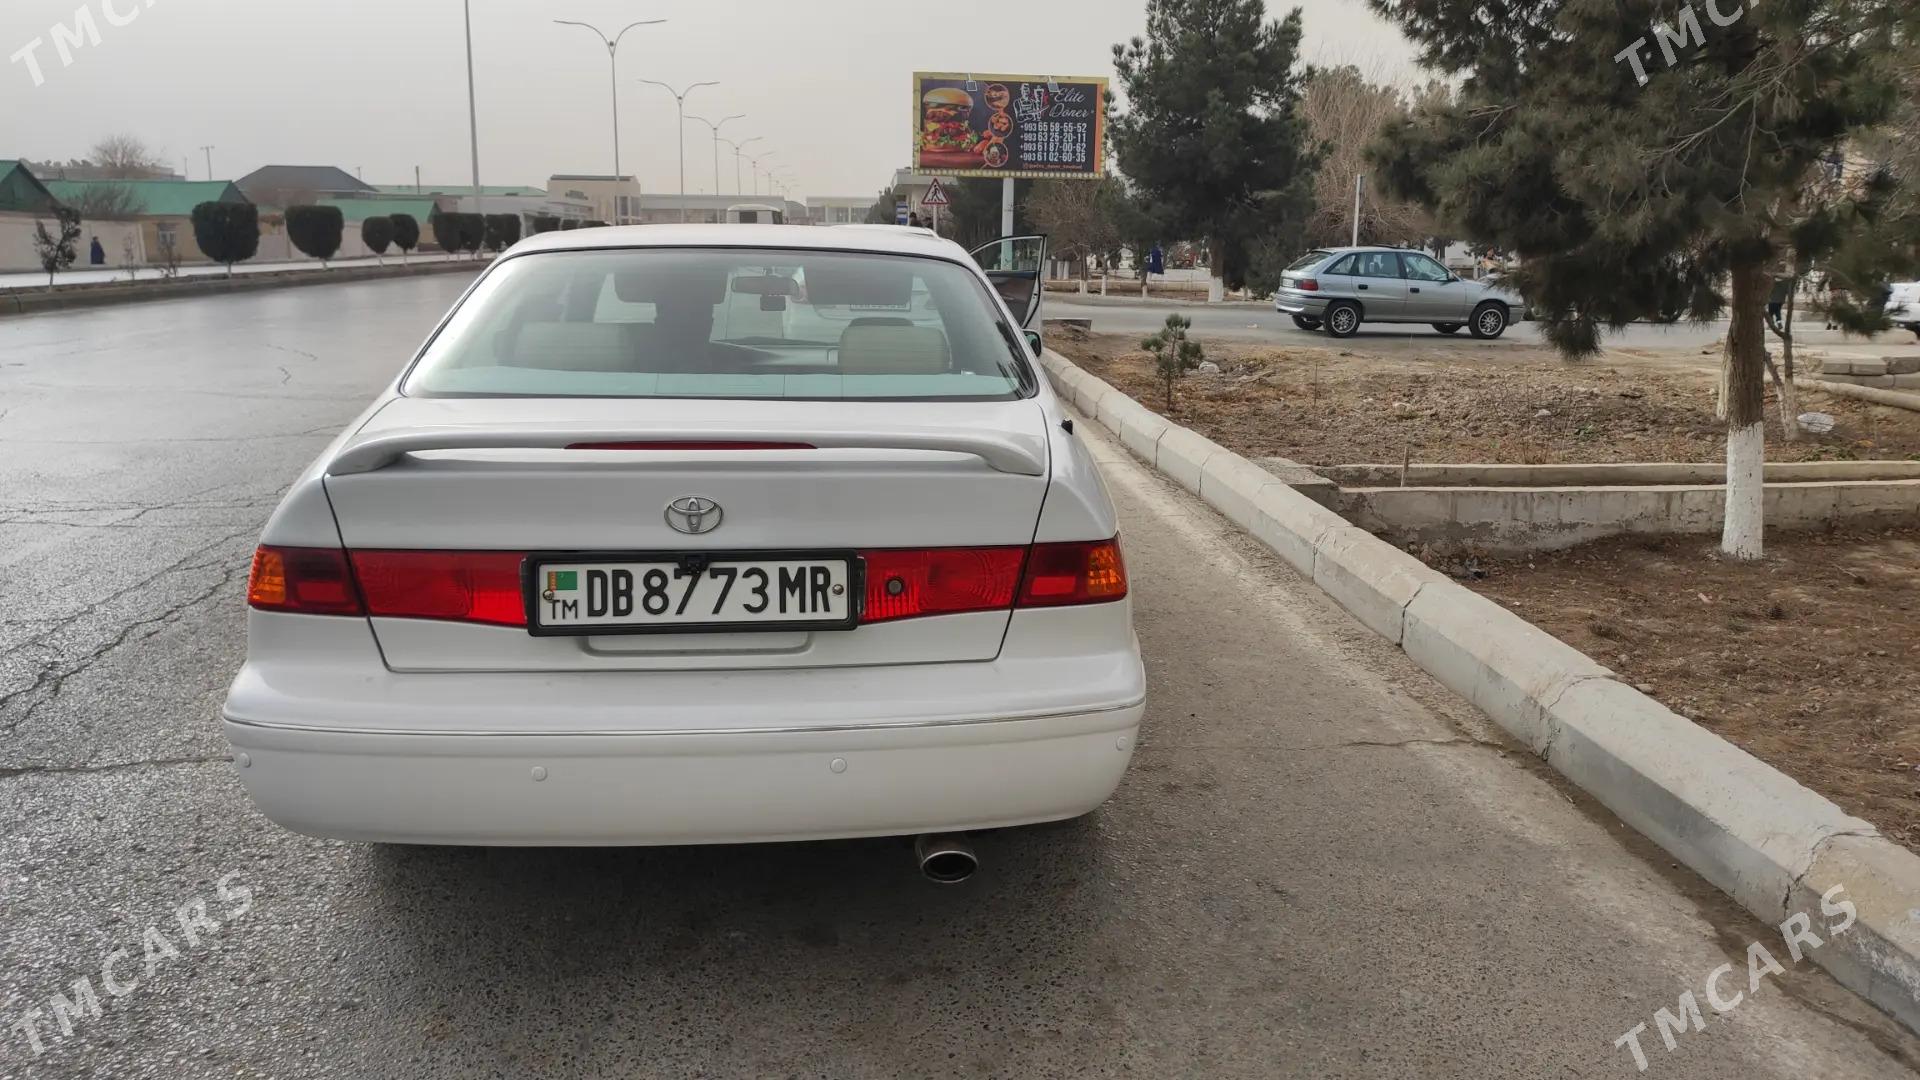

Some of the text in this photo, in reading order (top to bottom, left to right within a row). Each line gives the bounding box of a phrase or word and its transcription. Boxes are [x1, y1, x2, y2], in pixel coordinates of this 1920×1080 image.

[1054, 87, 1086, 103] Elite
[1020, 122, 1037, 132] +993
[1038, 121, 1048, 132] 65
[1020, 131, 1086, 142] +993 63 25-20-11
[1020, 142, 1036, 152] +993
[1037, 141, 1047, 152] 61
[1020, 152, 1036, 162] +993
[1037, 151, 1047, 162] 61
[551, 599, 578, 620] TM
